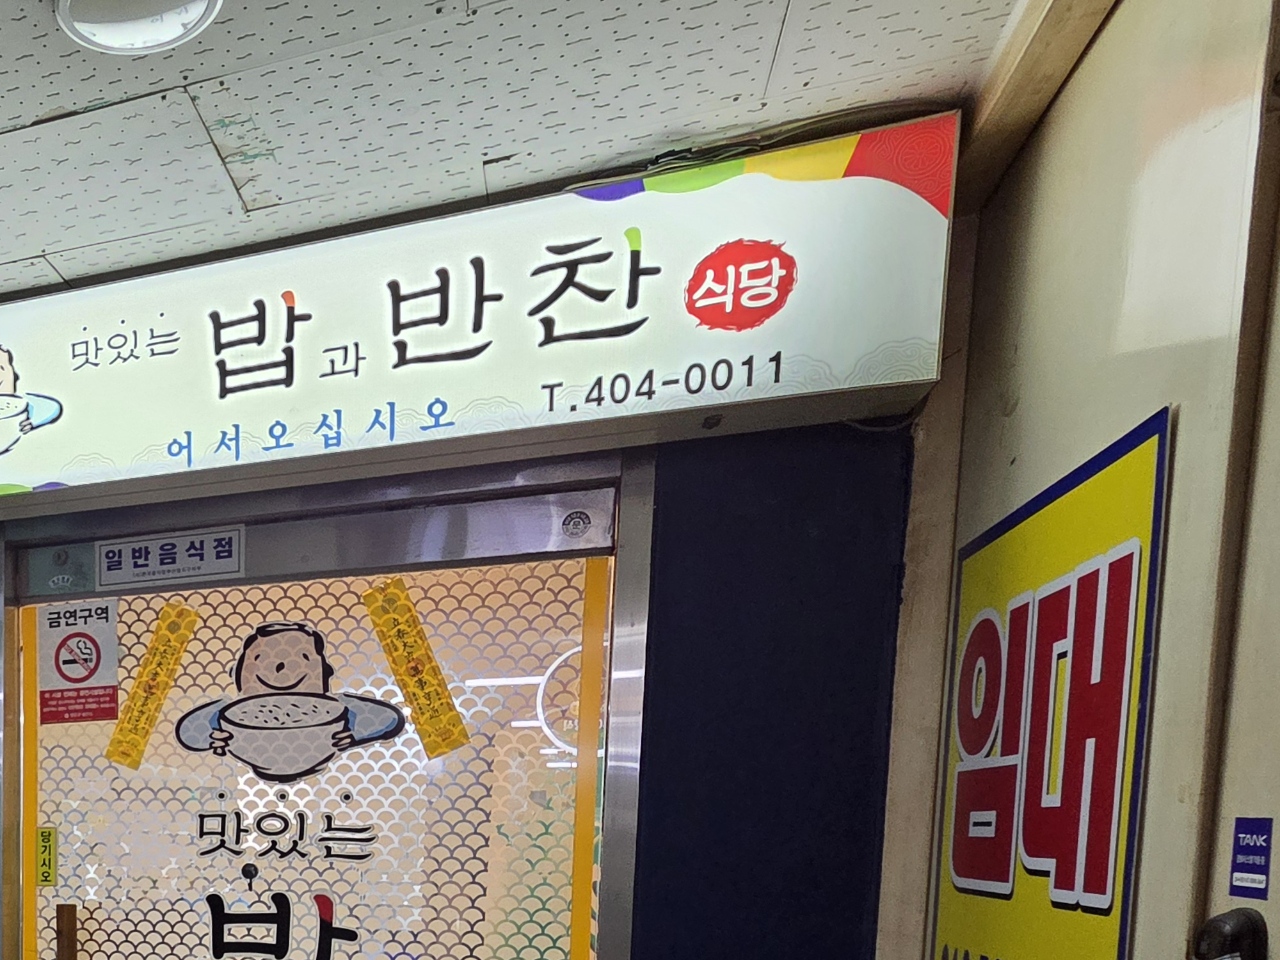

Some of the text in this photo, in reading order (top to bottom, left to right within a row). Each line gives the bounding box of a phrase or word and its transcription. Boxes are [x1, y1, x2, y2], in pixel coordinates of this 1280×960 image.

[70, 325, 181, 372] 맛있는
[692, 257, 786, 313] 식당
[541, 351, 783, 412] T.404-0011
[167, 398, 455, 468] 어서오십시오
[105, 536, 233, 571] 일반음식점
[47, 605, 109, 629] 금연구역
[951, 538, 1139, 908] 임대
[40, 830, 52, 882] 당기시오
[198, 811, 378, 860] 맛있는
[1238, 833, 1268, 846] TANK
